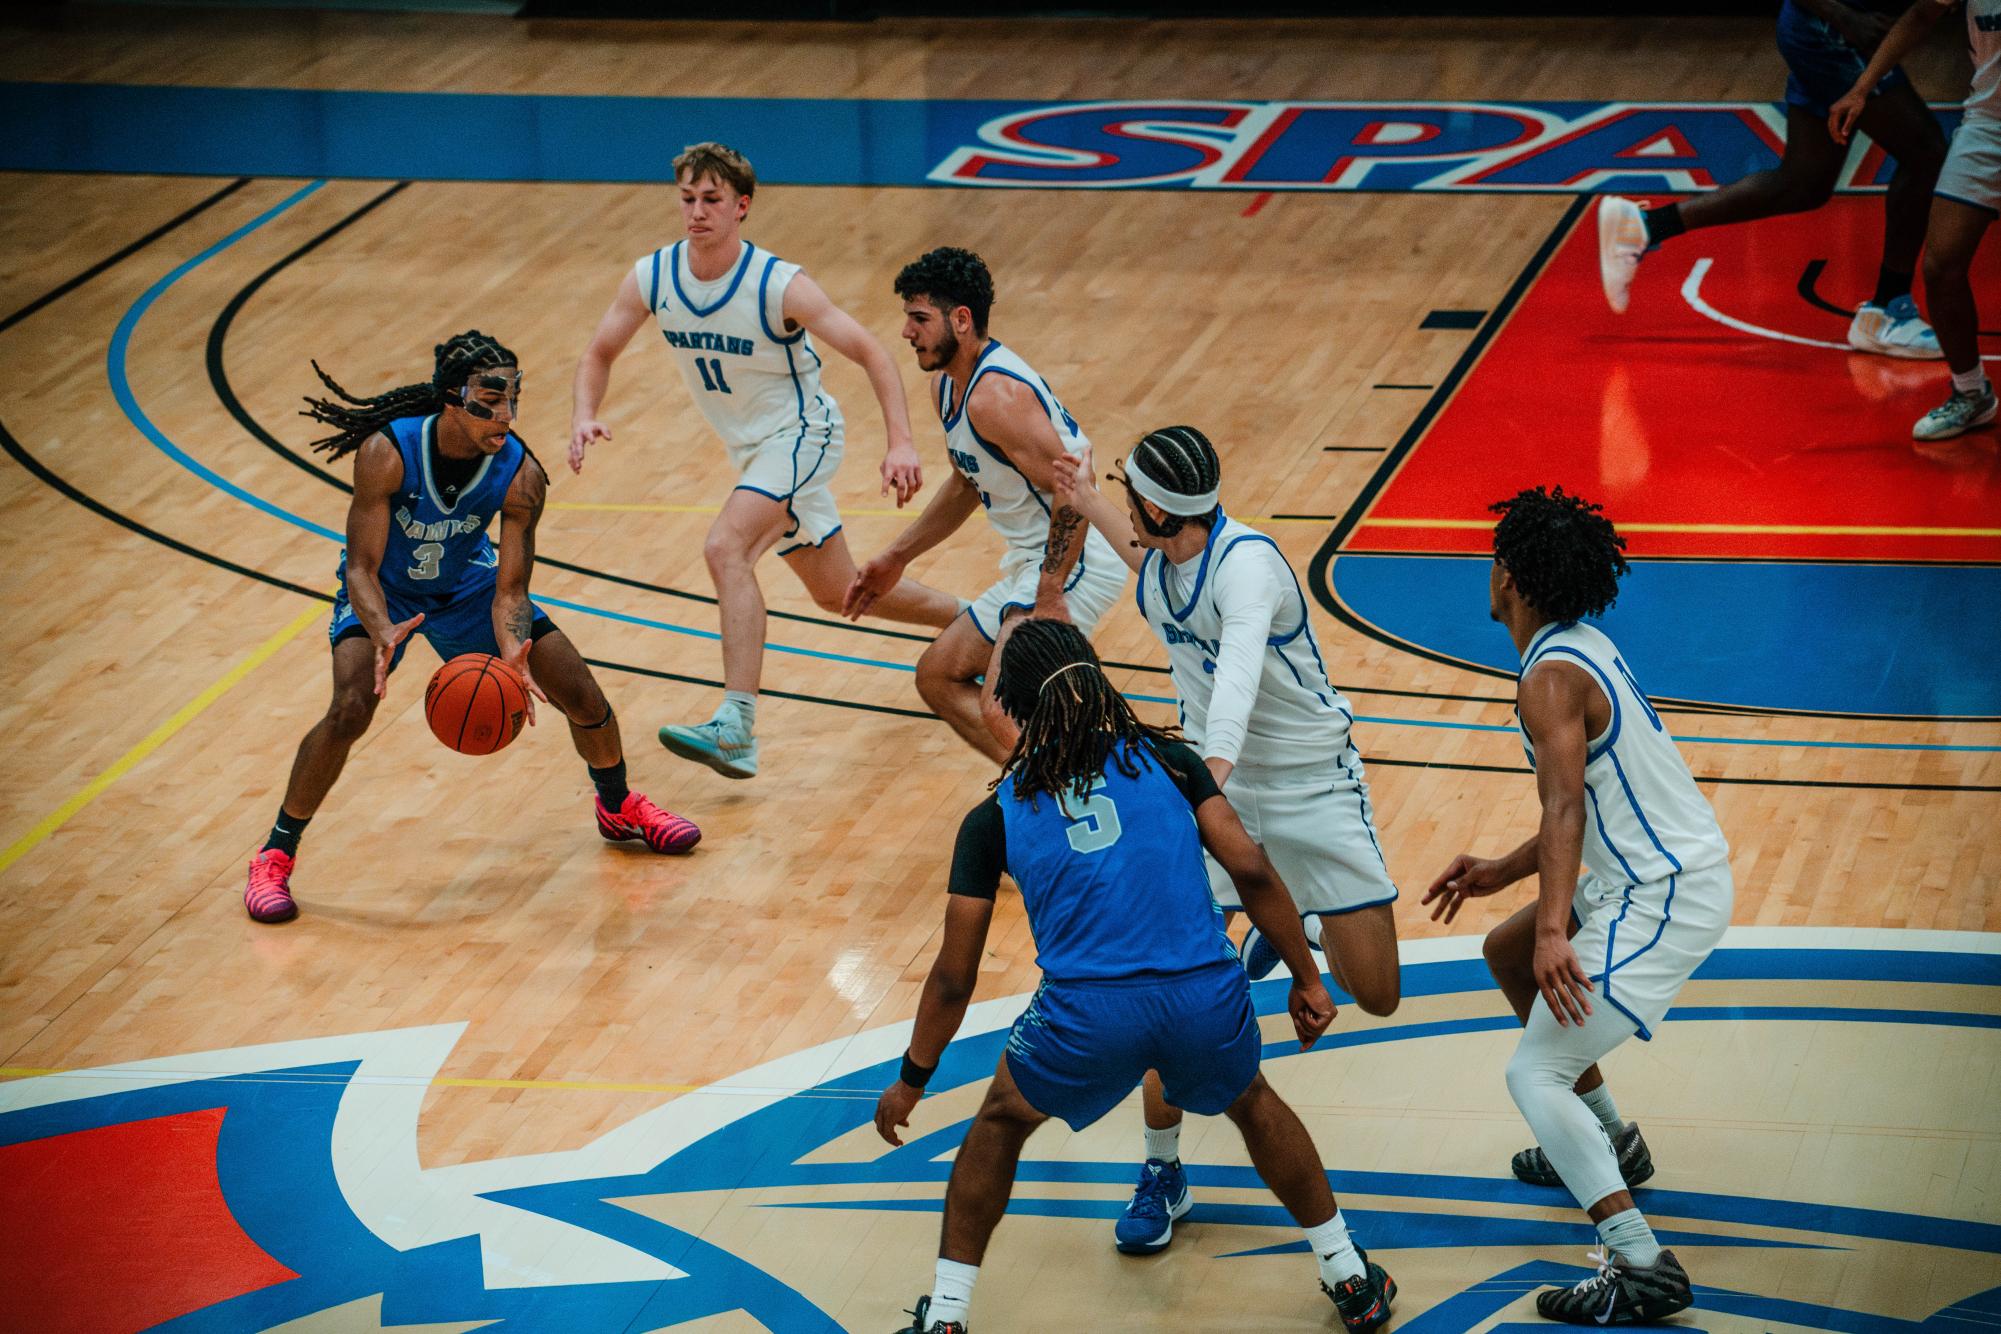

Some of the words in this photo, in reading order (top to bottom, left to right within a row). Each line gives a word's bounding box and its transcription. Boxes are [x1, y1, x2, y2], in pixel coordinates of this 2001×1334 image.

[926, 99, 1966, 193] SPA
[662, 329, 754, 356] PARTANS
[695, 357, 732, 394] 11
[407, 543, 444, 580] 3
[1055, 772, 1122, 854] 5
